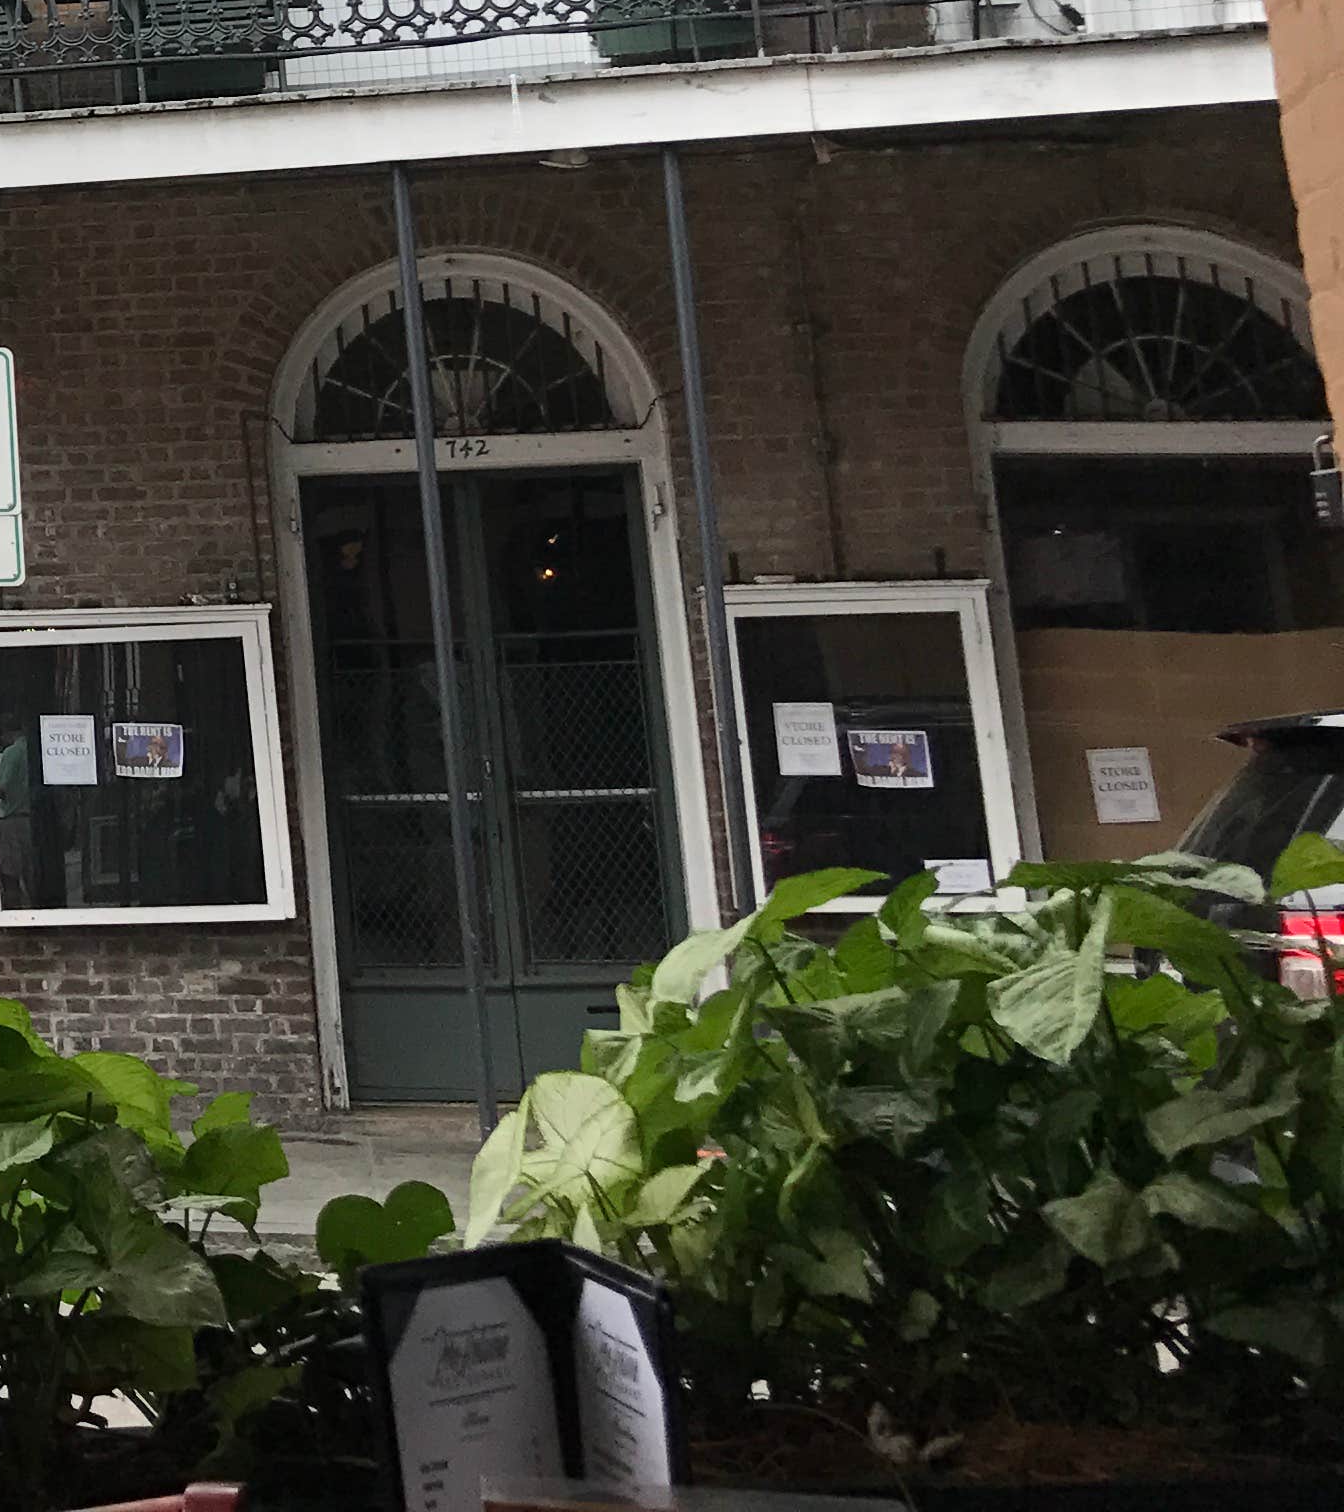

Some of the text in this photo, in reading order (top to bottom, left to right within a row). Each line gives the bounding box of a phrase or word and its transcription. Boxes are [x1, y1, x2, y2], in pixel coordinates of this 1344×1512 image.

[445, 439, 490, 458] 742
[49, 733, 86, 743] STORE
[782, 736, 832, 745] CLOSED
[47, 747, 90, 757] CLOSED
[1100, 767, 1141, 776] STORE
[1098, 781, 1148, 792] CLOSED
